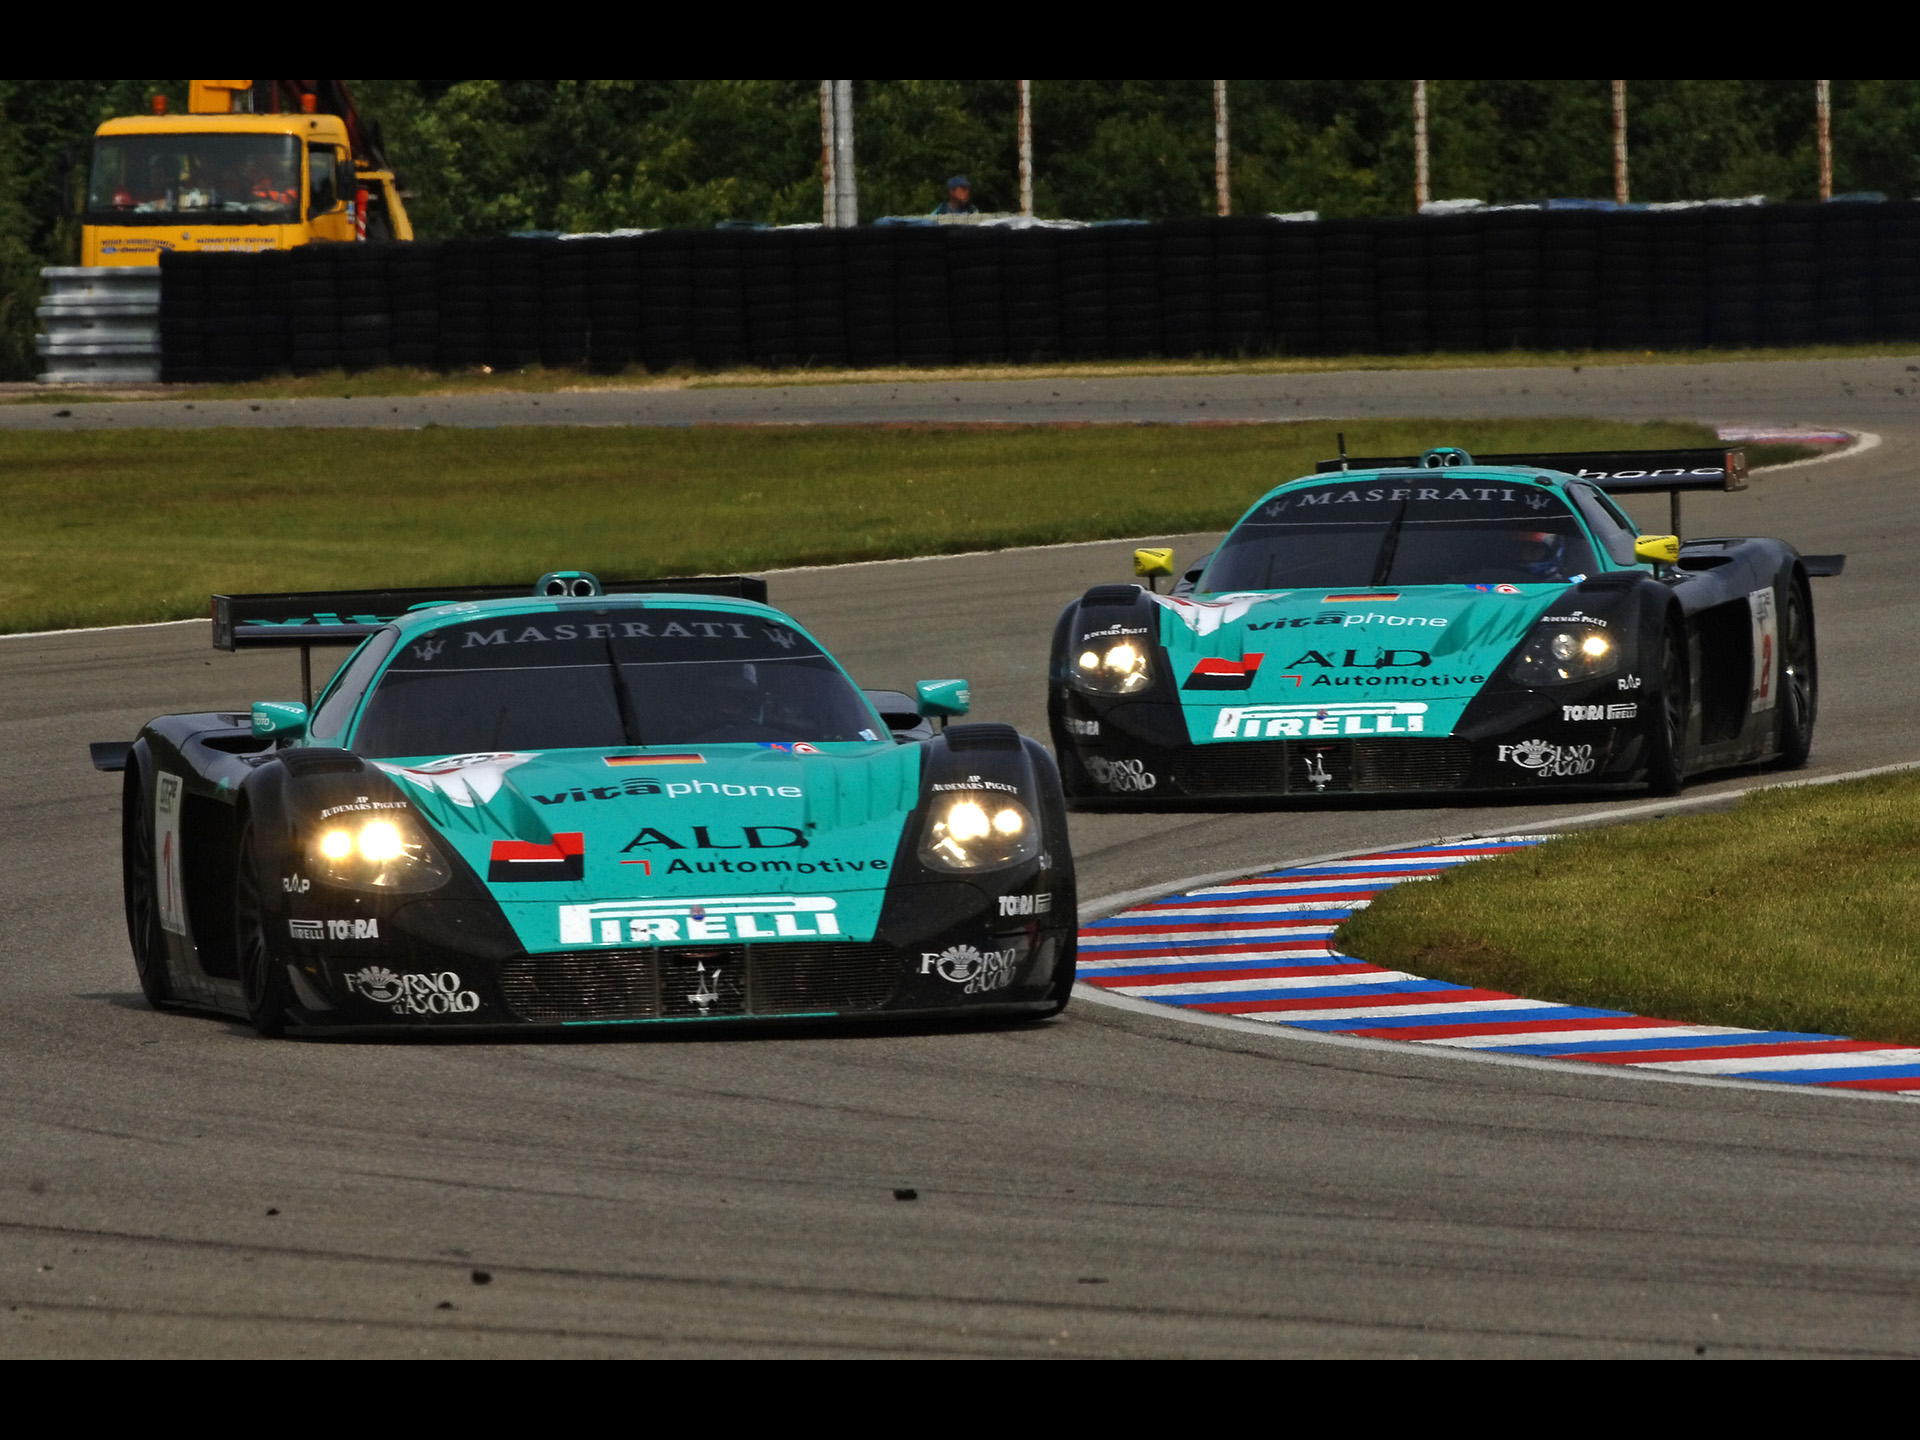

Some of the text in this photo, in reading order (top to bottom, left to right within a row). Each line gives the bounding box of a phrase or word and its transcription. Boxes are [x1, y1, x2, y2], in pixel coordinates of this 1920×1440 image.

[1296, 488, 1516, 507] MASERATI
[1247, 611, 1448, 631] vitaphone
[461, 622, 751, 648] MASERATI
[1284, 649, 1433, 669] ALD
[1760, 633, 1772, 698] 2
[1311, 673, 1485, 687] Automotive
[1213, 702, 1429, 738] PIRELLI
[1606, 702, 1638, 720] PIRELLI
[532, 777, 803, 806] vitaphone
[320, 803, 371, 820] AUDEMARS
[621, 825, 808, 853] ALD
[667, 857, 889, 875] Automotive
[288, 918, 325, 940] PIRELLI
[558, 896, 841, 944] PIRELLI
[392, 990, 480, 1014] d'ASOLO
